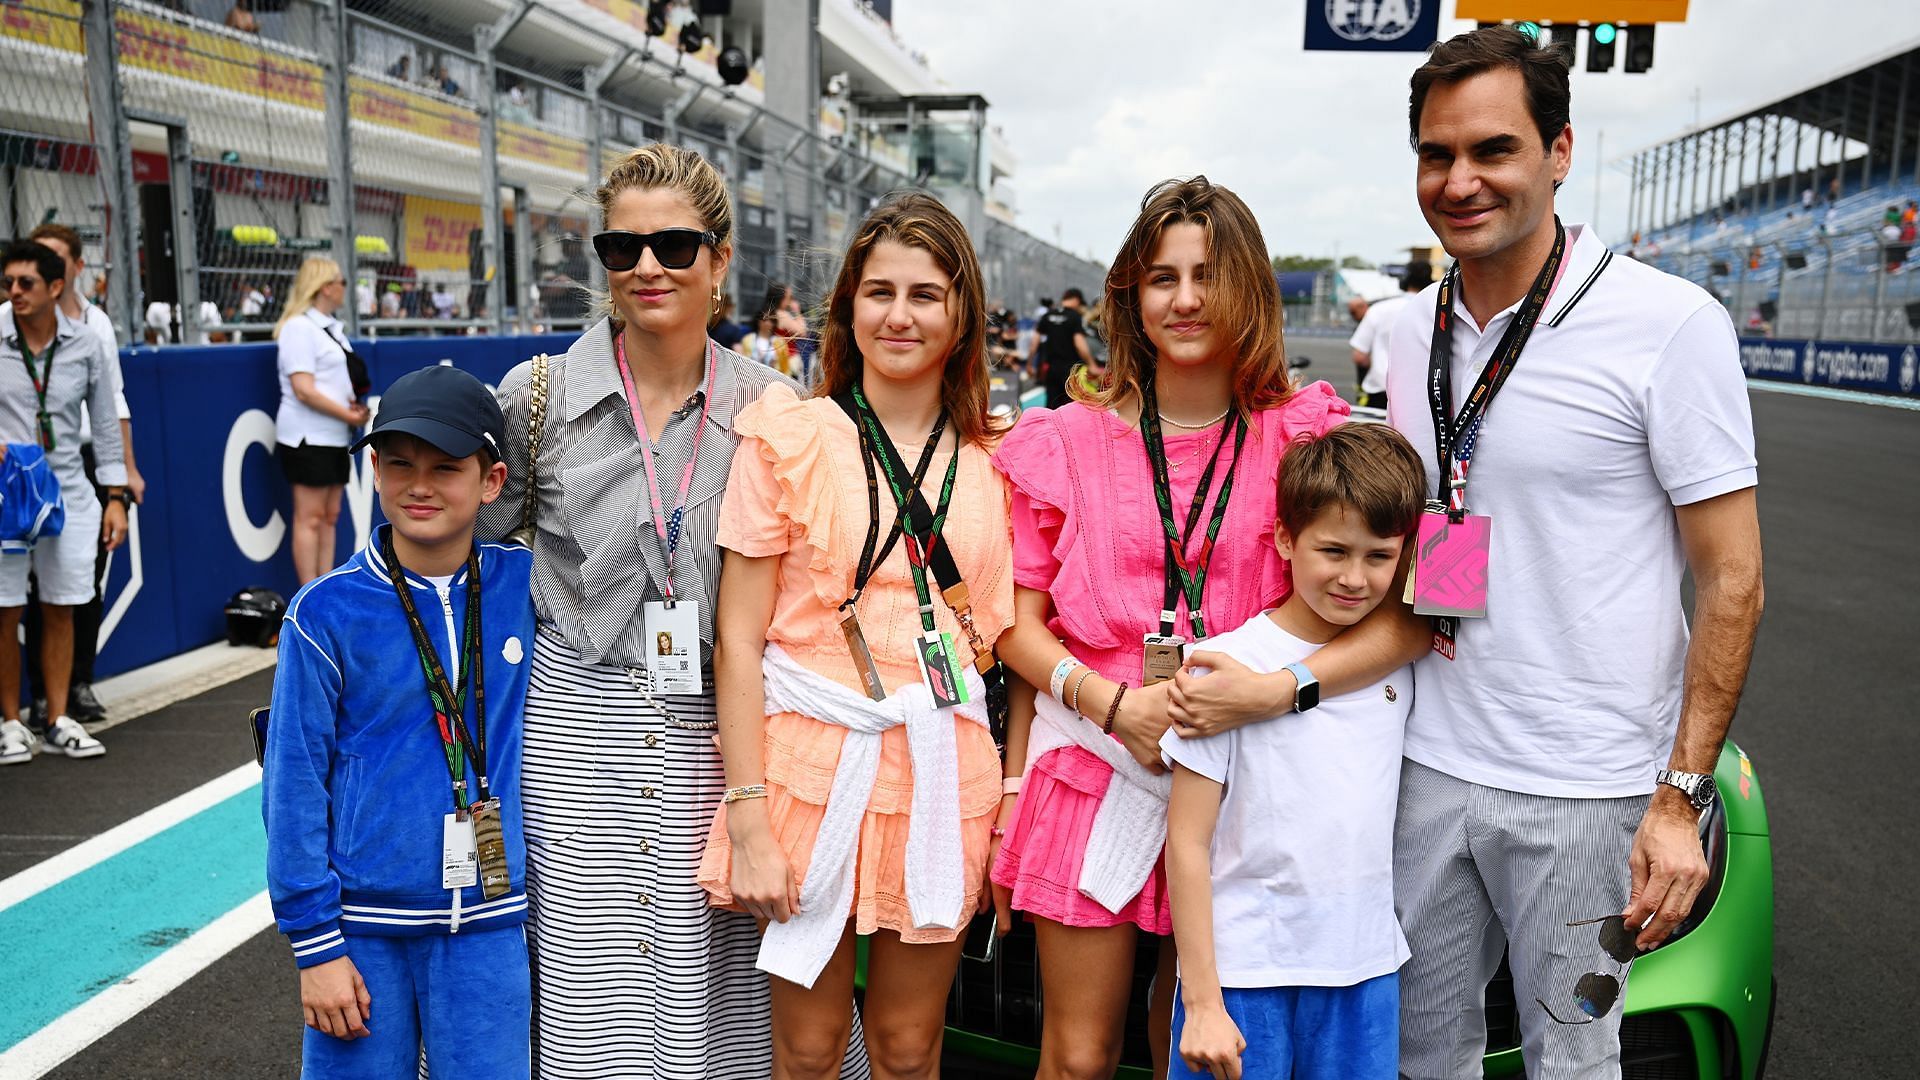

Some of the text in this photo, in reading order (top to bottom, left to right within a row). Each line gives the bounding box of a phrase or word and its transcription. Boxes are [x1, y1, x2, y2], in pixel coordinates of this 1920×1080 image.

[1331, 0, 1409, 29] FIA
[1816, 345, 1890, 384] crypto.com
[1433, 368, 1442, 411] LAPS
[1437, 413, 1446, 448] HOT
[1439, 618, 1451, 636] 01
[944, 639, 961, 680] PADDOCK
[1433, 635, 1455, 659] SUN
